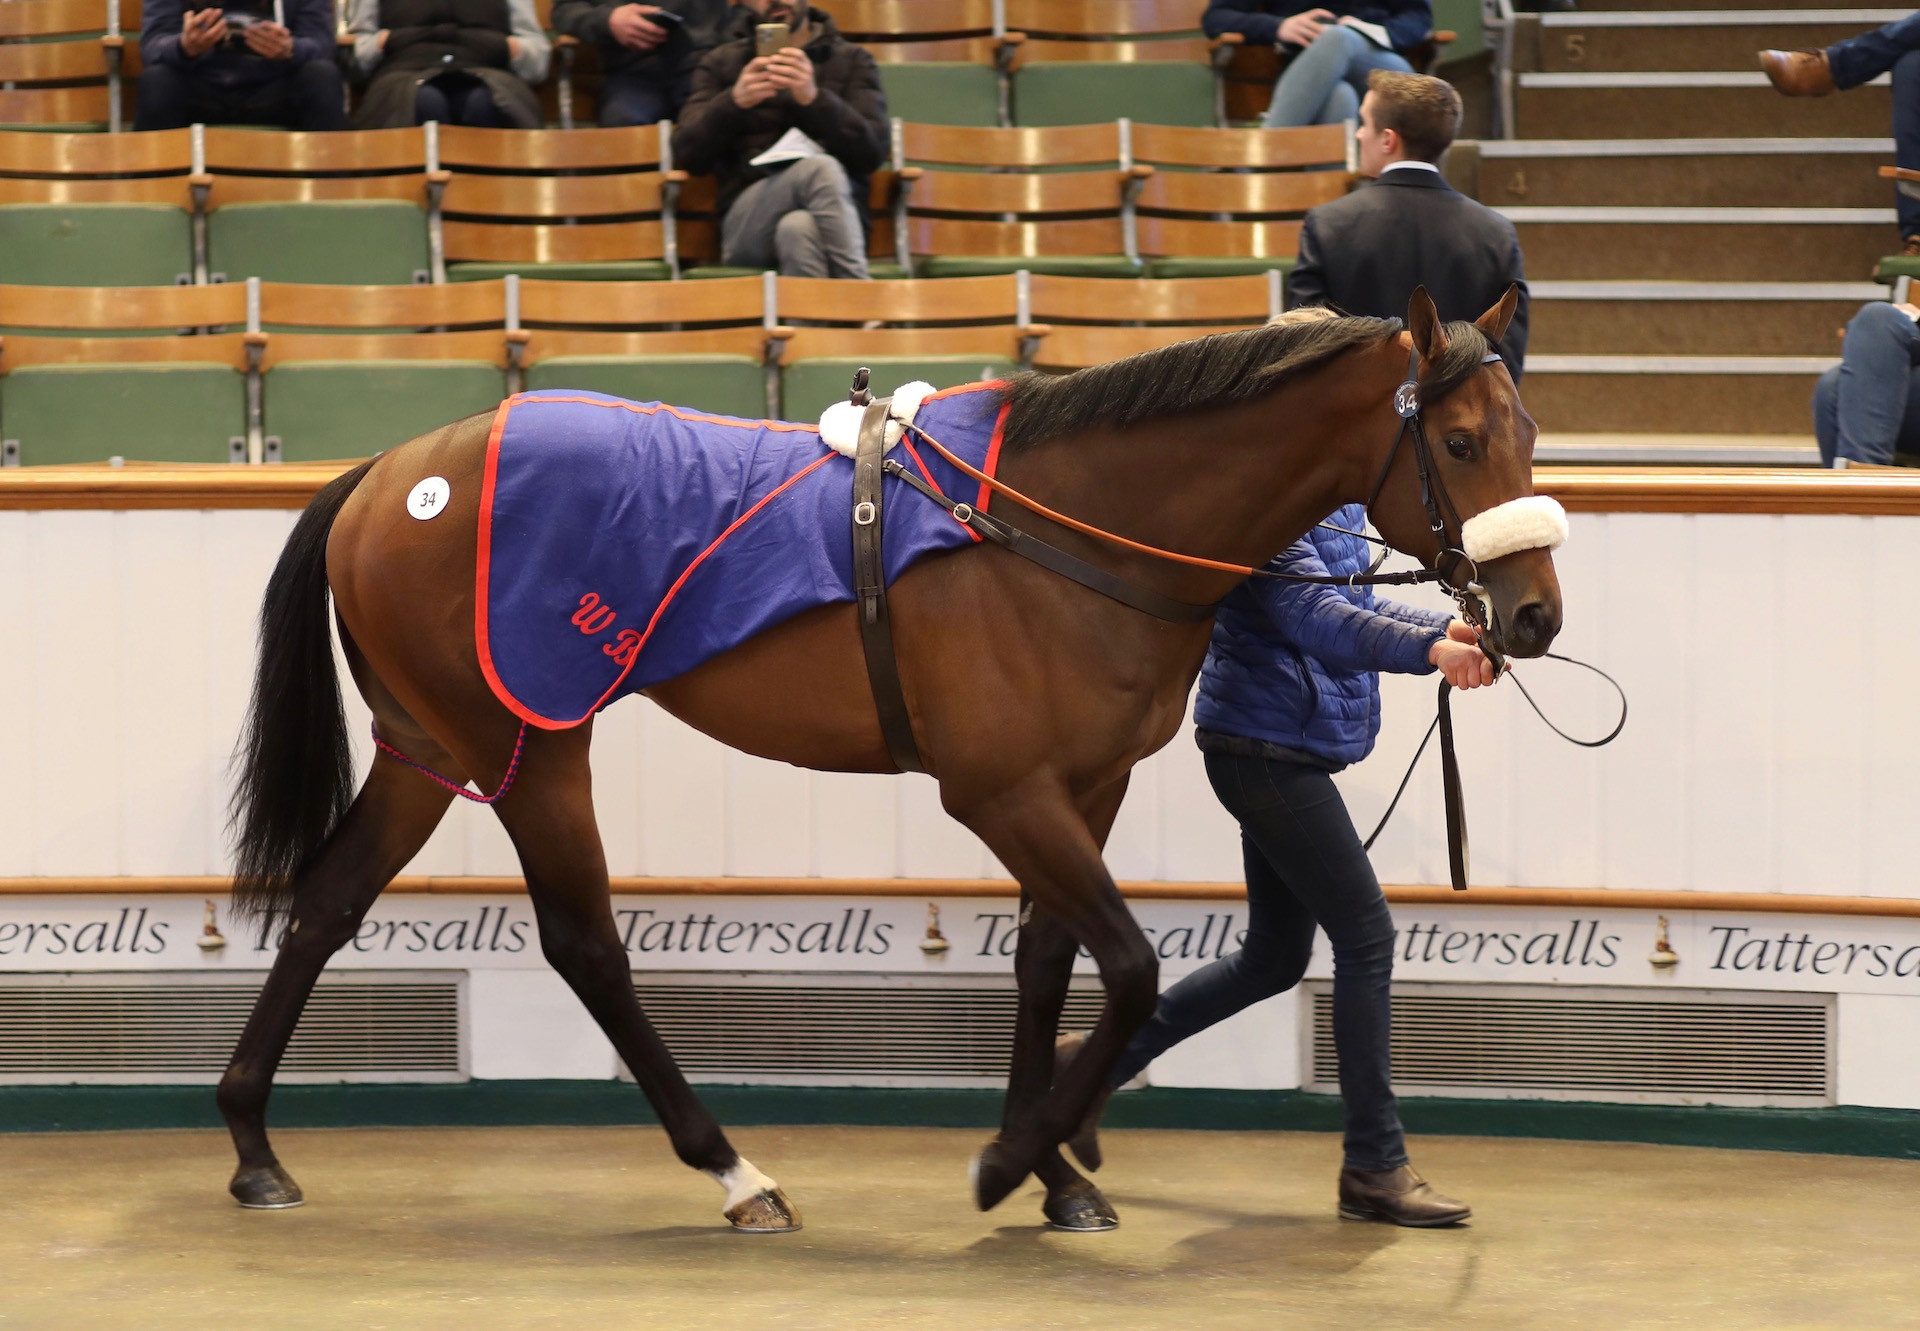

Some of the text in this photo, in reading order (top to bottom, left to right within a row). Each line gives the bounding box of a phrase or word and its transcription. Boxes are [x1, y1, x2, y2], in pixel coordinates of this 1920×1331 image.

[1566, 34, 1586, 61] 5
[1398, 394, 1418, 414] 34
[420, 492, 436, 507] 34
[0, 906, 170, 955] ersalls
[253, 905, 530, 952] Tersalls
[616, 907, 894, 955] Tattersalls
[1393, 918, 1623, 968] ttersalls
[1709, 925, 1920, 978] Tattersa
